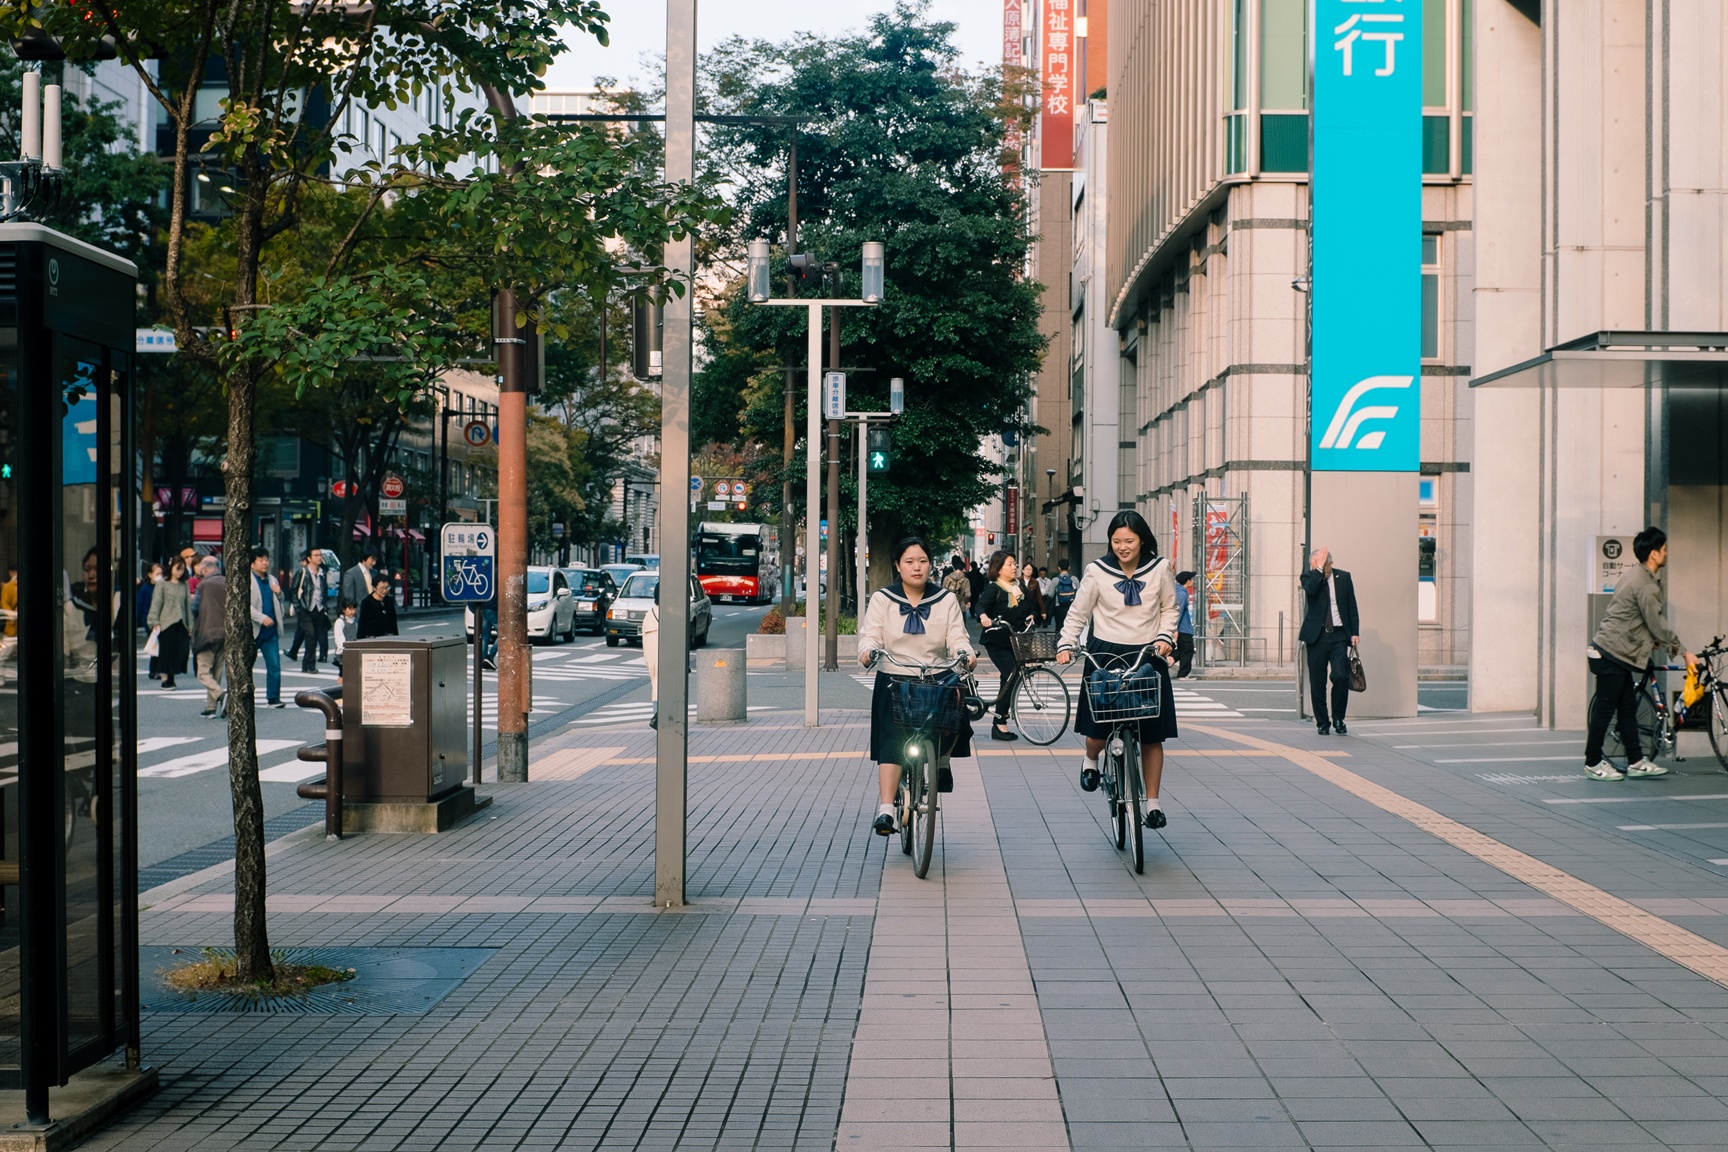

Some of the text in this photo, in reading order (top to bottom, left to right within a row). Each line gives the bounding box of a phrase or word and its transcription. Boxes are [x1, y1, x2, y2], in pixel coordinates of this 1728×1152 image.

[1334, 0, 1404, 77] 行
[448, 533, 474, 543] 駐輪場
